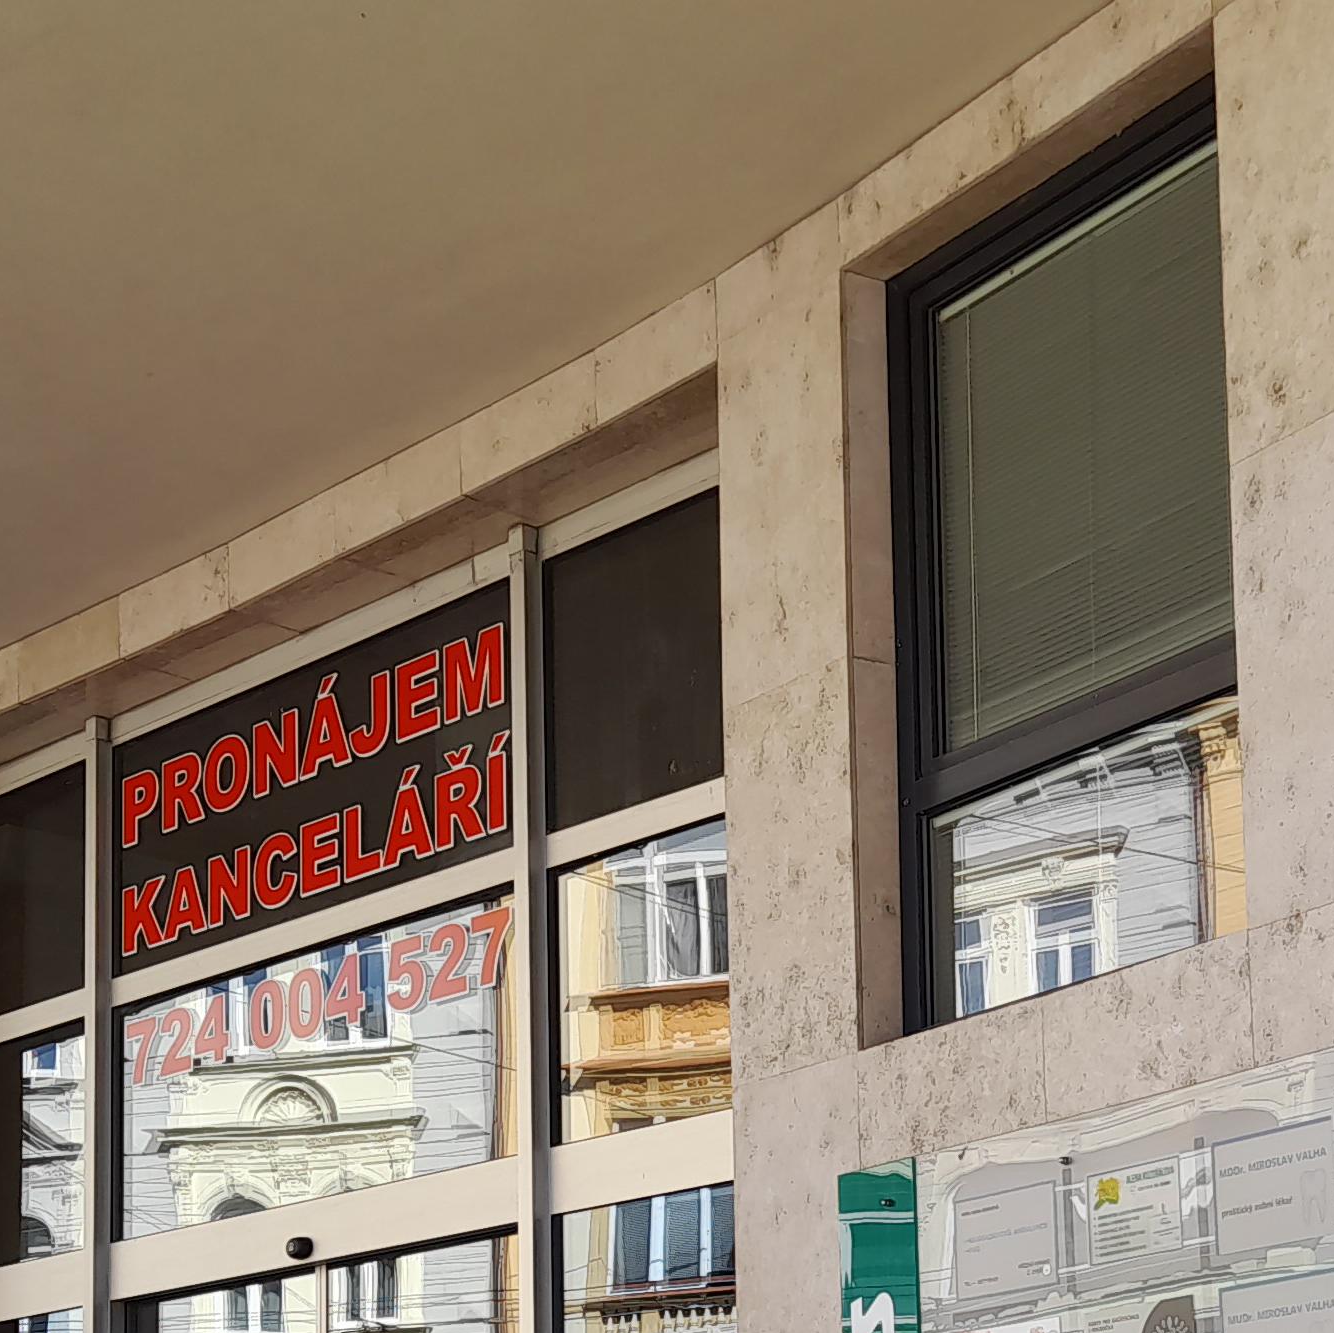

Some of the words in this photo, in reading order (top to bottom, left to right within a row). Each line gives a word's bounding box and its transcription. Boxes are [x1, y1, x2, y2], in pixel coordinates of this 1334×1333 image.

[121, 622, 505, 848] PRONÁJEM
[121, 730, 511, 957] KANCELÁŘÍ
[126, 995, 229, 1086] 724
[249, 953, 364, 1051] 004
[388, 907, 514, 1014] 527
